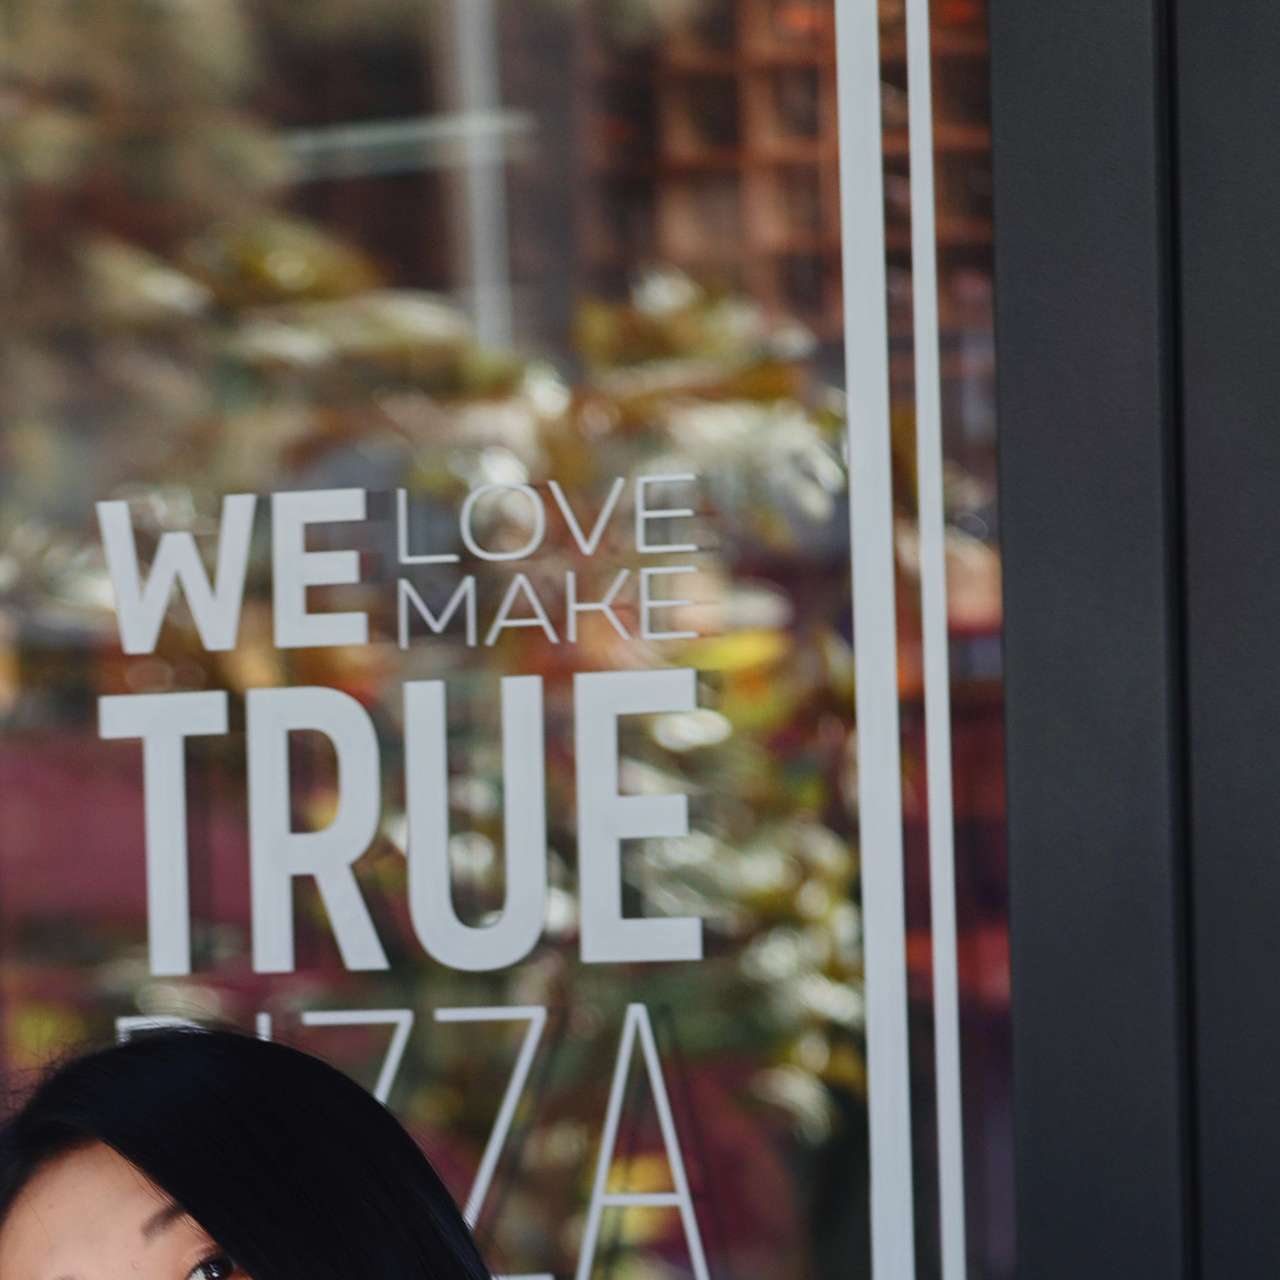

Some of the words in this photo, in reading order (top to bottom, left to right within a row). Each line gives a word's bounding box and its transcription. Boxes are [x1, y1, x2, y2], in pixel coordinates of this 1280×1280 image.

[95, 488, 369, 655] WE
[397, 473, 699, 565] LOVE
[398, 565, 700, 649] MAKE
[98, 668, 704, 976] TRUE
